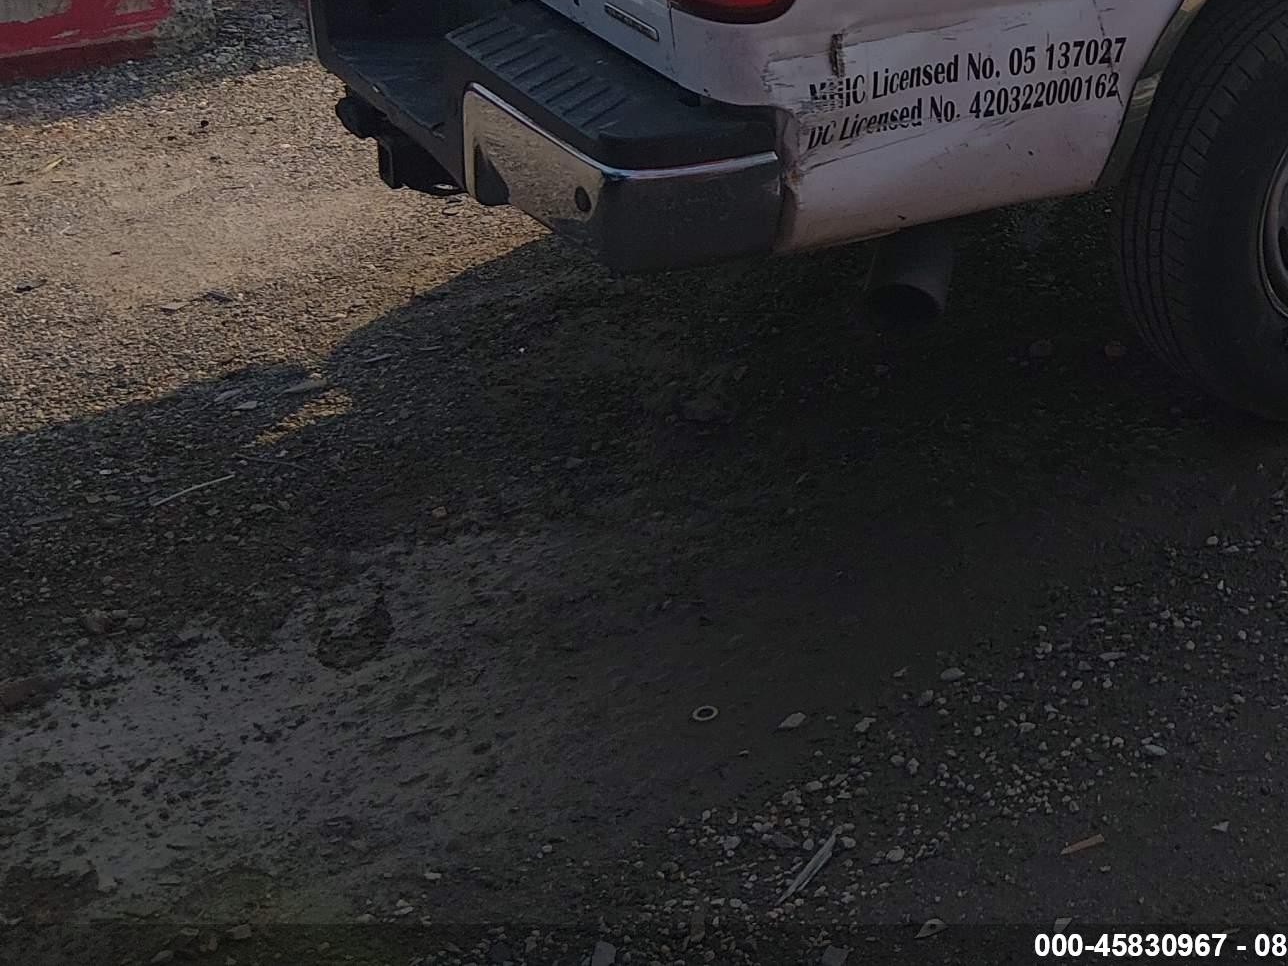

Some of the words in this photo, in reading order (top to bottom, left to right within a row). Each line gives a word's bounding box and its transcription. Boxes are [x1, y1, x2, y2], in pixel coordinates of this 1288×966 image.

[872, 54, 959, 100] Licensed
[967, 51, 1001, 83] No.
[1009, 47, 1036, 77] 05
[1045, 37, 1127, 72] 137027
[807, 120, 836, 151] DC
[839, 97, 923, 141] Licensed
[930, 93, 961, 124] No.
[969, 71, 1119, 120] 420322000162
